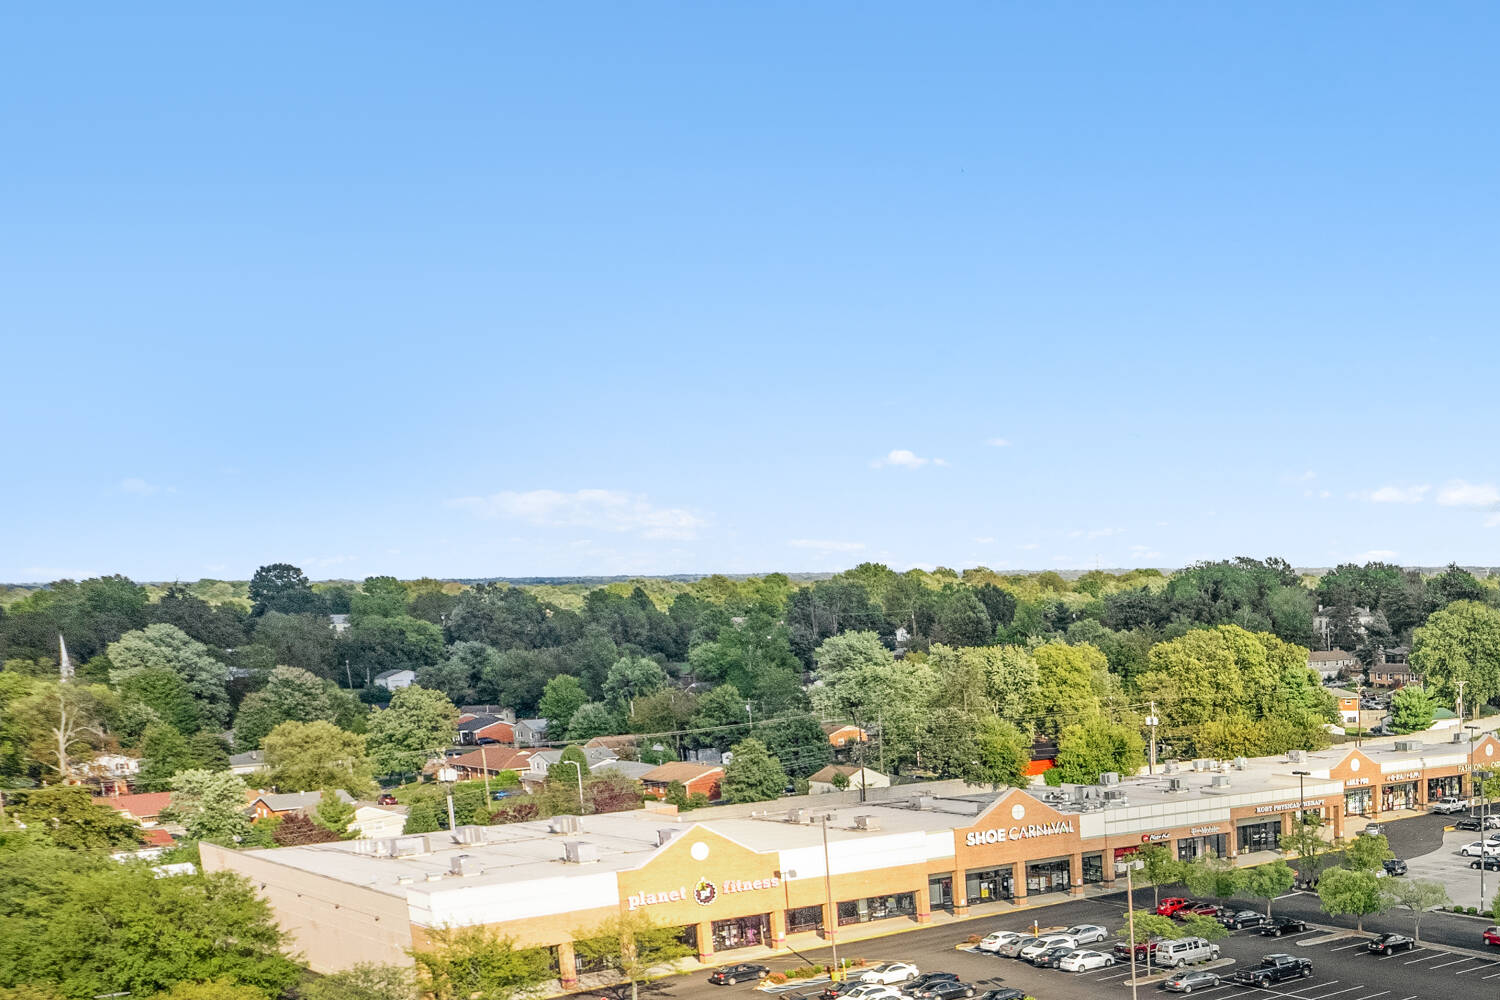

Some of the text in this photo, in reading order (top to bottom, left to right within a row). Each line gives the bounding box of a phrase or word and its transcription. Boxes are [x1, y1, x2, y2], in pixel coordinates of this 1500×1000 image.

[966, 820, 1075, 846] SHOE CARNIVAL
[627, 886, 687, 911] planet
[721, 876, 780, 895] fitness
